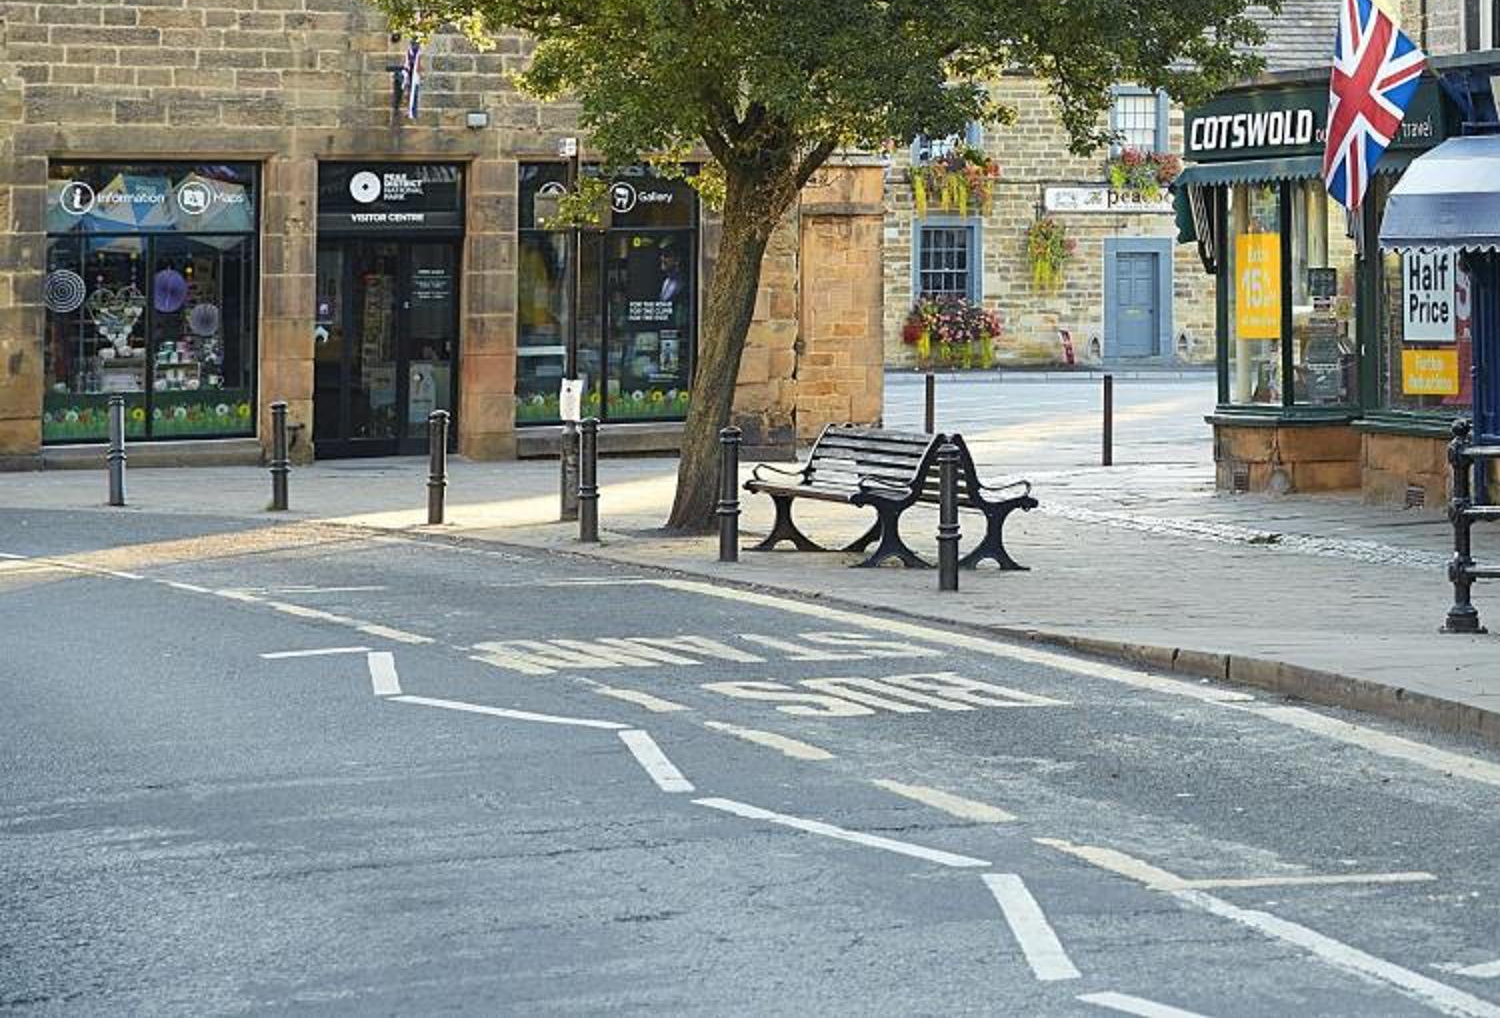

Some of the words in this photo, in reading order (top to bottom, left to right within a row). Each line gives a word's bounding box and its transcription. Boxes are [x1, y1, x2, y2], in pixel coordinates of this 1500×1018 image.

[1190, 109, 1313, 151] COTSWOLD
[1402, 115, 1433, 138] travel
[97, 189, 165, 203] Information
[213, 190, 245, 204] Maps
[638, 191, 673, 204] Gallery
[351, 213, 387, 222] VISITOR
[388, 213, 425, 222] CENTRE
[1409, 253, 1449, 290] Half
[1409, 293, 1449, 323] Price
[702, 670, 1073, 718] BUS
